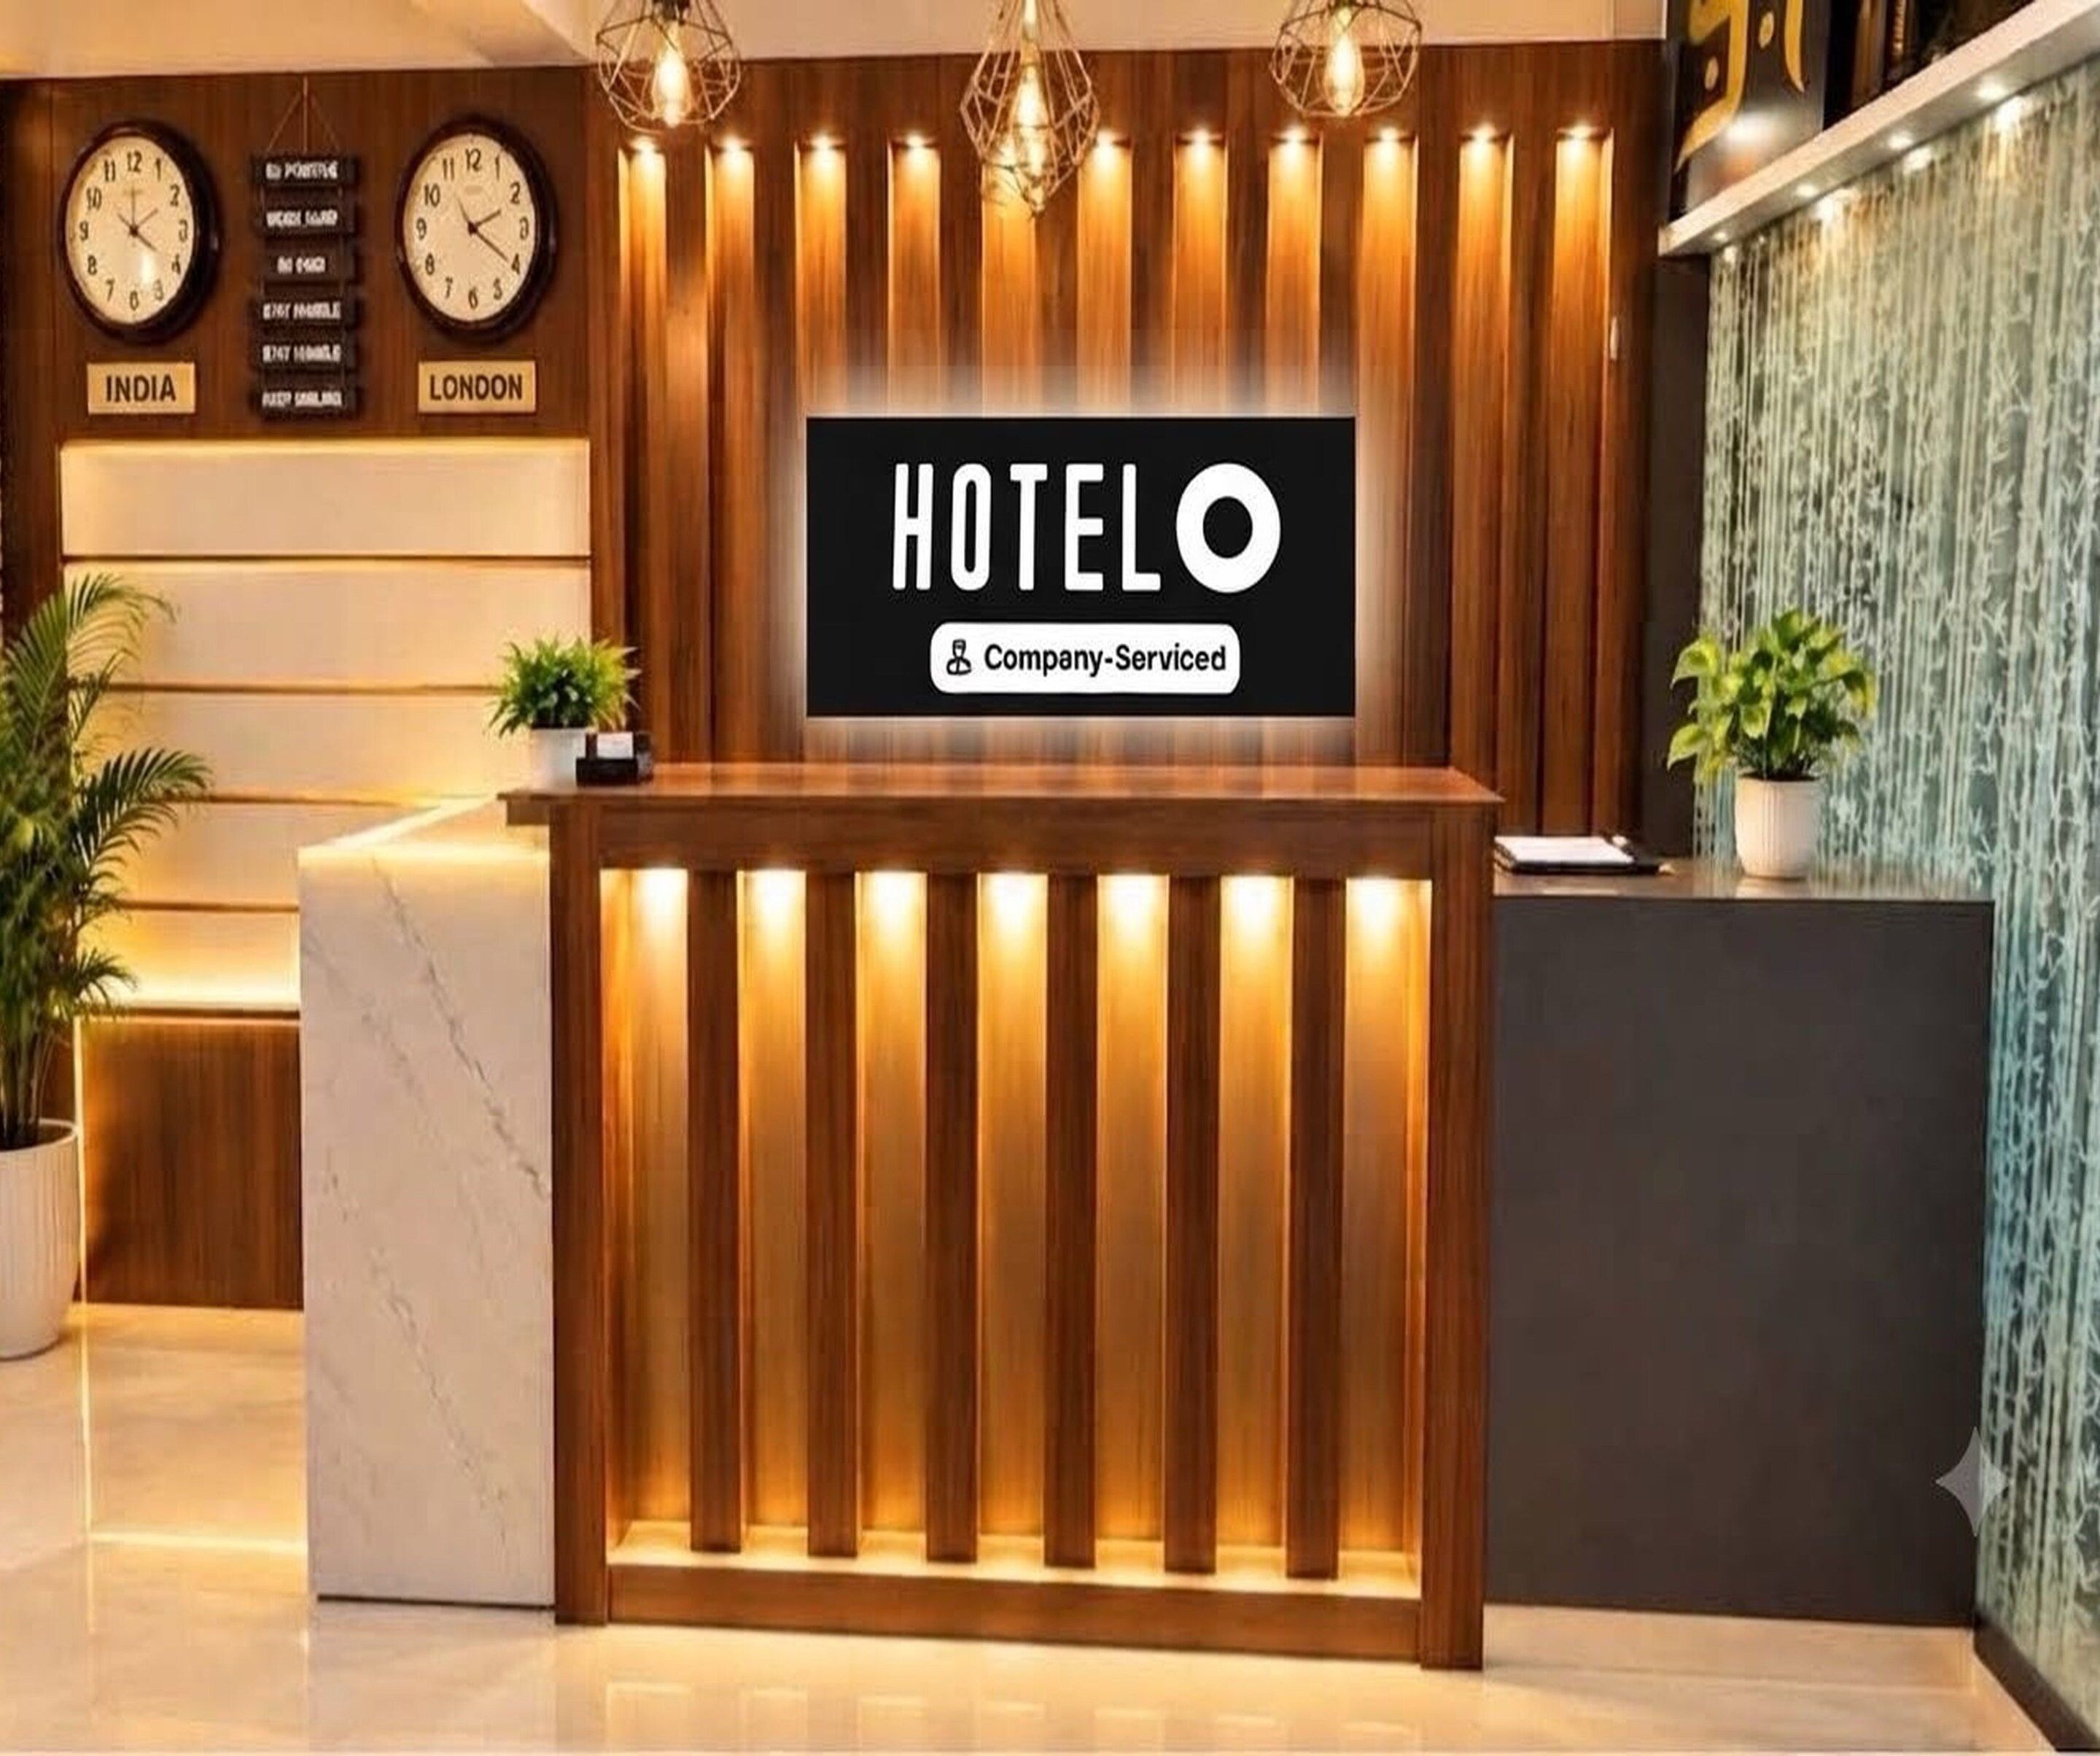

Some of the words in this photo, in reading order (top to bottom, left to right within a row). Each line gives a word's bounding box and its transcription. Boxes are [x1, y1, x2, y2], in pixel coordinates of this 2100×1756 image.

[104, 160, 115, 181] 11
[127, 151, 142, 173] 12
[155, 158, 162, 180] 1
[443, 158, 454, 180] 11
[465, 148, 481, 171] 12
[494, 157, 500, 179] 1
[171, 185, 179, 206] 2
[424, 184, 440, 206] 10
[510, 183, 521, 204] 2
[79, 222, 89, 241] 9
[416, 219, 427, 240] 9
[88, 255, 97, 275] 8
[425, 253, 435, 274] 8
[511, 254, 520, 274] 4
[106, 279, 114, 302] 7
[106, 375, 175, 402] INDIA
[430, 374, 522, 400] LONDON
[984, 645, 1226, 677] Company-Serviced
